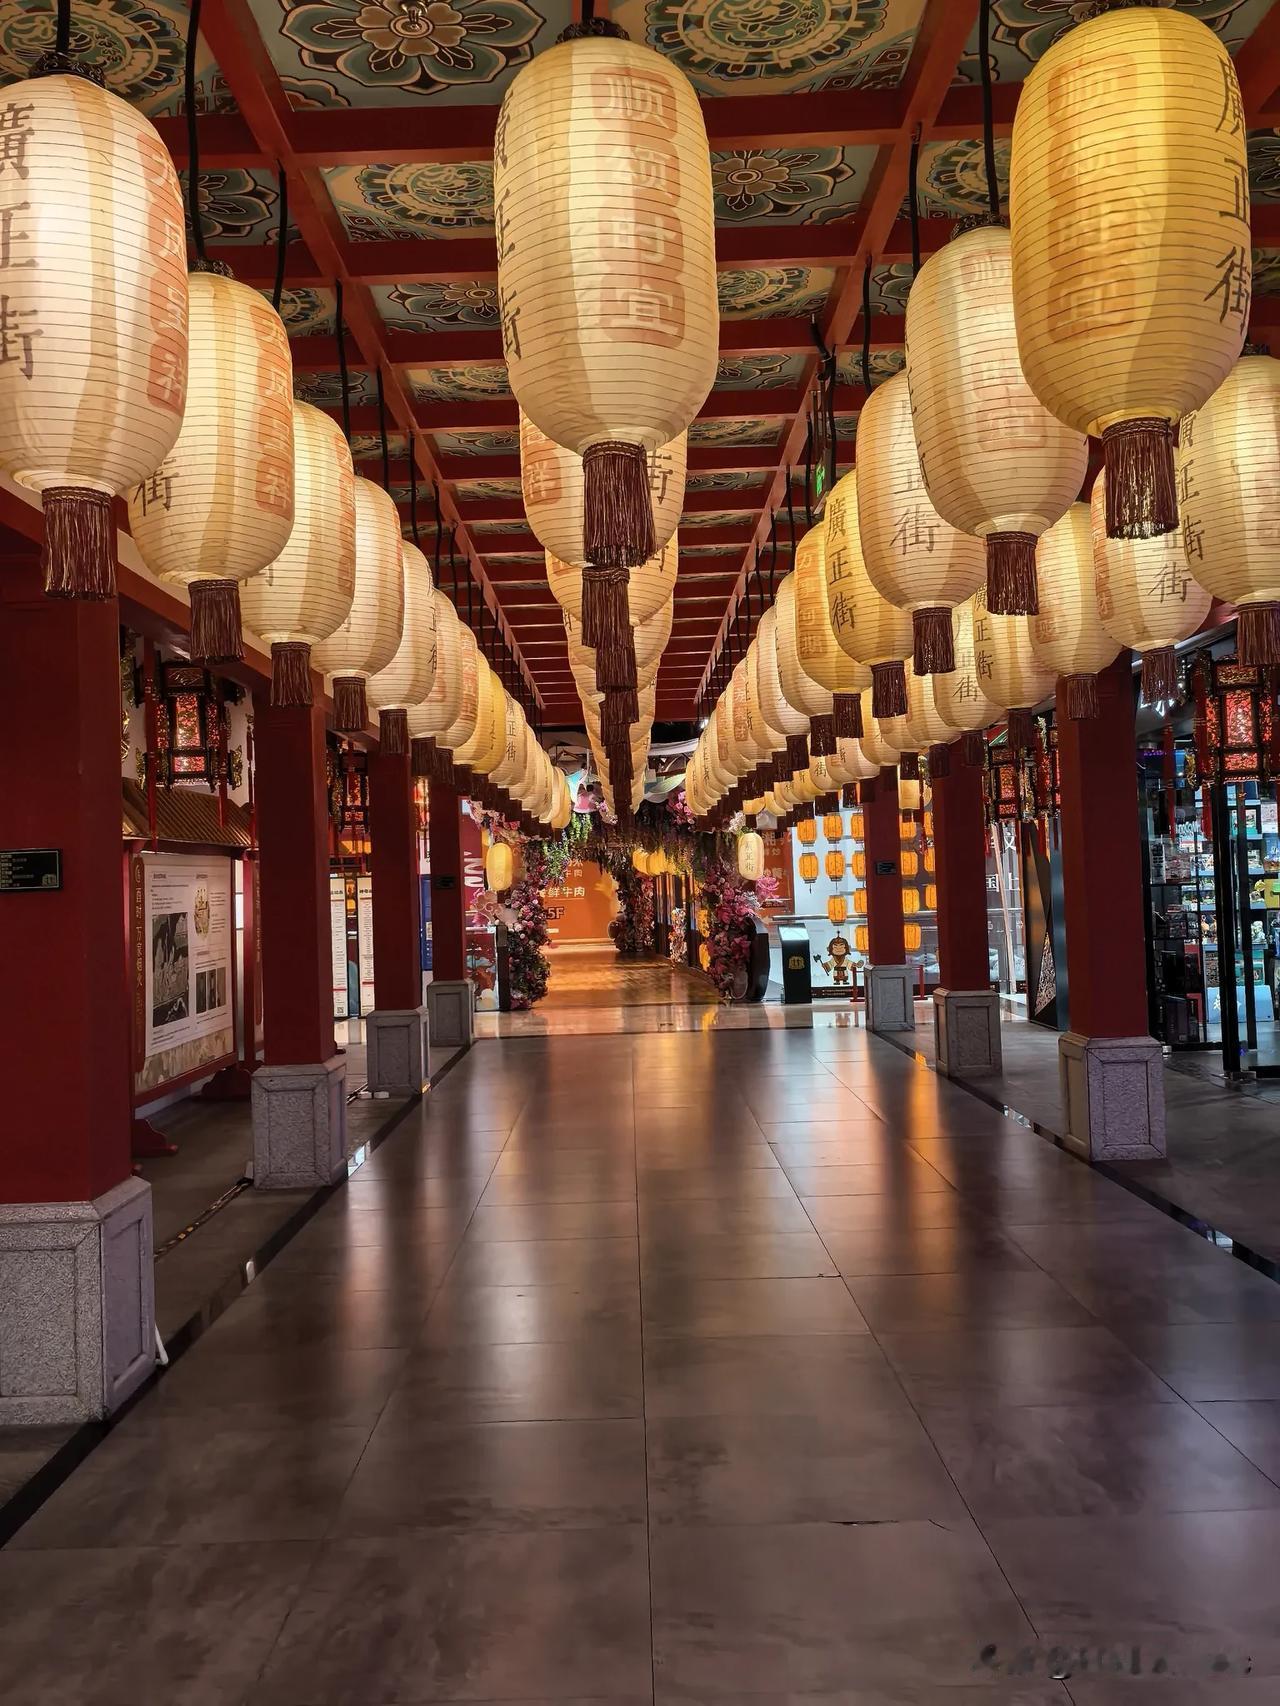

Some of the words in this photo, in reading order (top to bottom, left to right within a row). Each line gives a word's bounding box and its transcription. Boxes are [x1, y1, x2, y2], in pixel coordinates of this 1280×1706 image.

[1204, 55, 1250, 336] 廣正街
[1180, 411, 1205, 565] 廣正街
[827, 498, 857, 634] 廣正街
